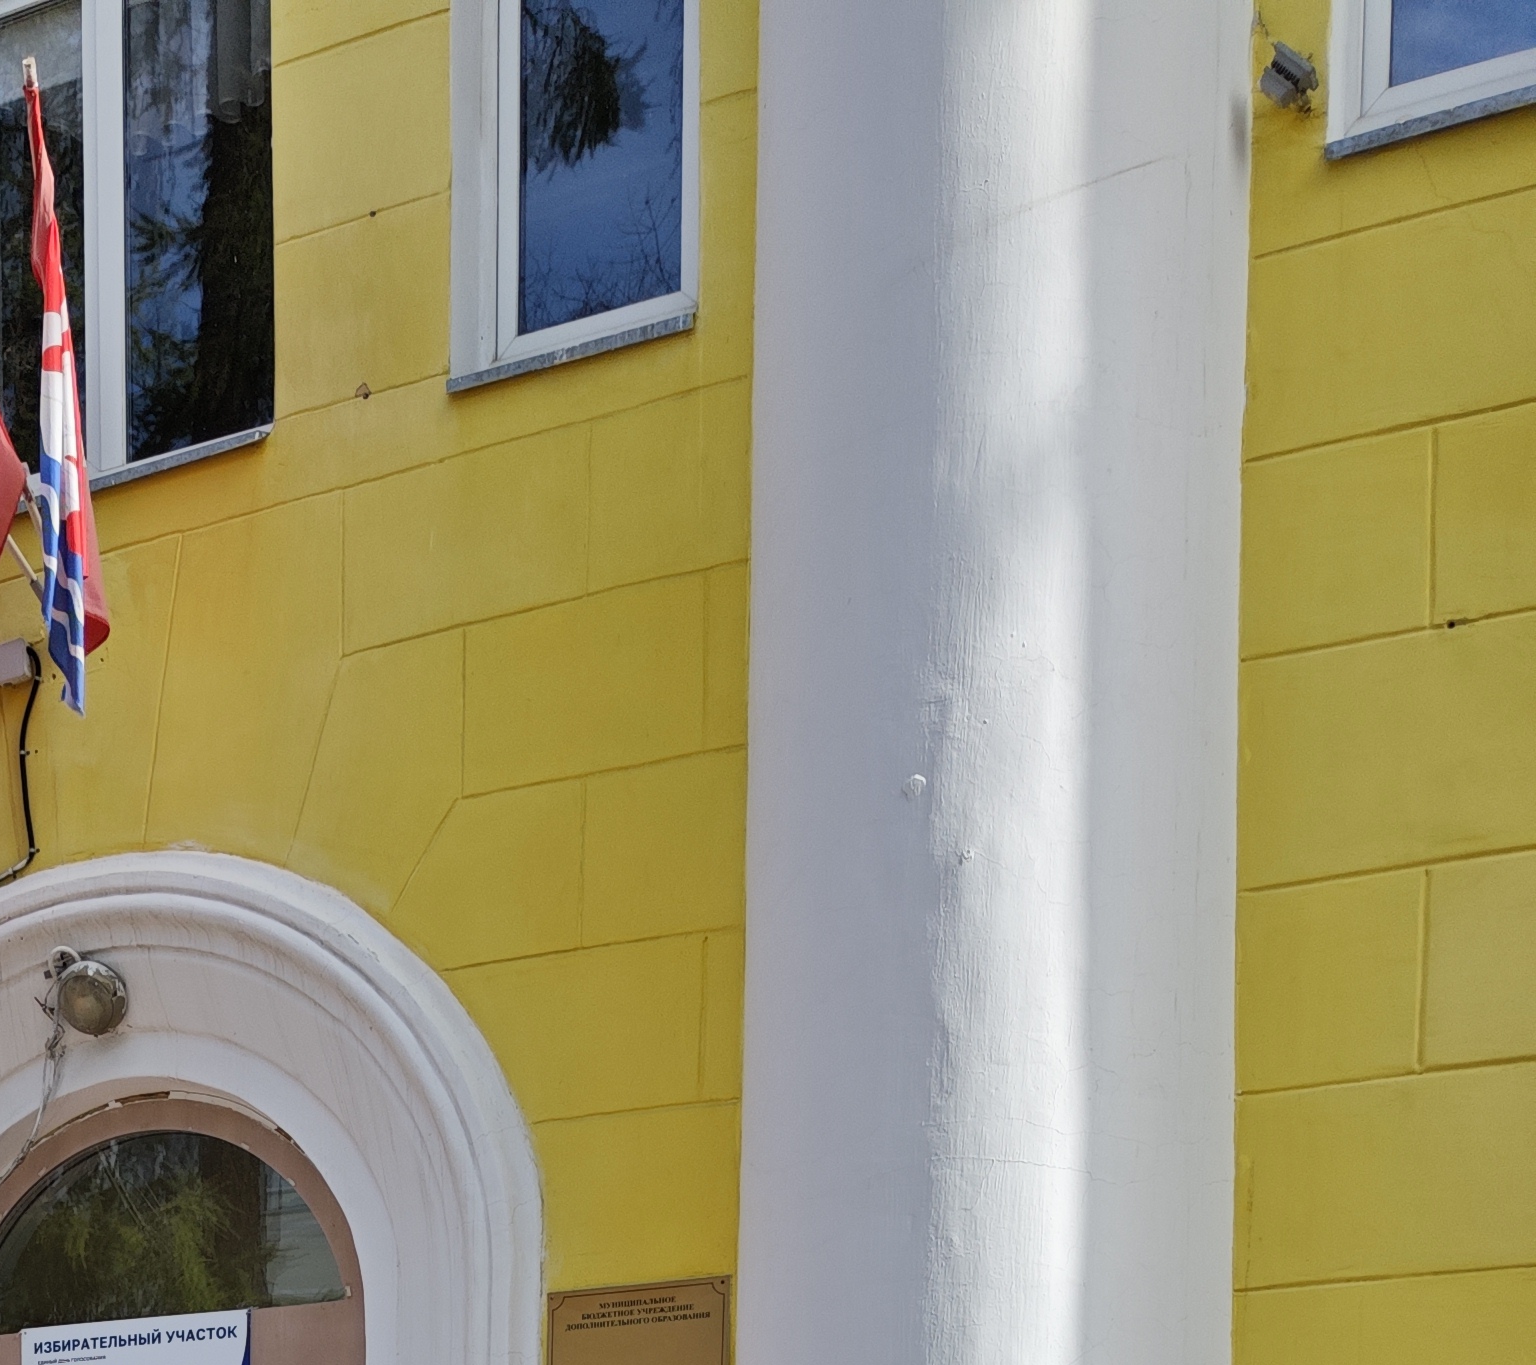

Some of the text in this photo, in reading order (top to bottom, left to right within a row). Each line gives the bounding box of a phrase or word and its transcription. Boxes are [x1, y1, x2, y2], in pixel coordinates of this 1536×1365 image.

[581, 1303, 695, 1321] БЮДЖЕТНОЕ УЧРЕЖДЕНИЕ
[598, 1296, 677, 1310] МУНИЦИПАЛЬНОЕ
[565, 1311, 711, 1332] ДОПОЛНИТЕЛЬНОГО ОБРАЗОВАНИЯ
[34, 1325, 238, 1355] ИЗБИРАТЕЛЬНЫЙ УЧАСТОК
